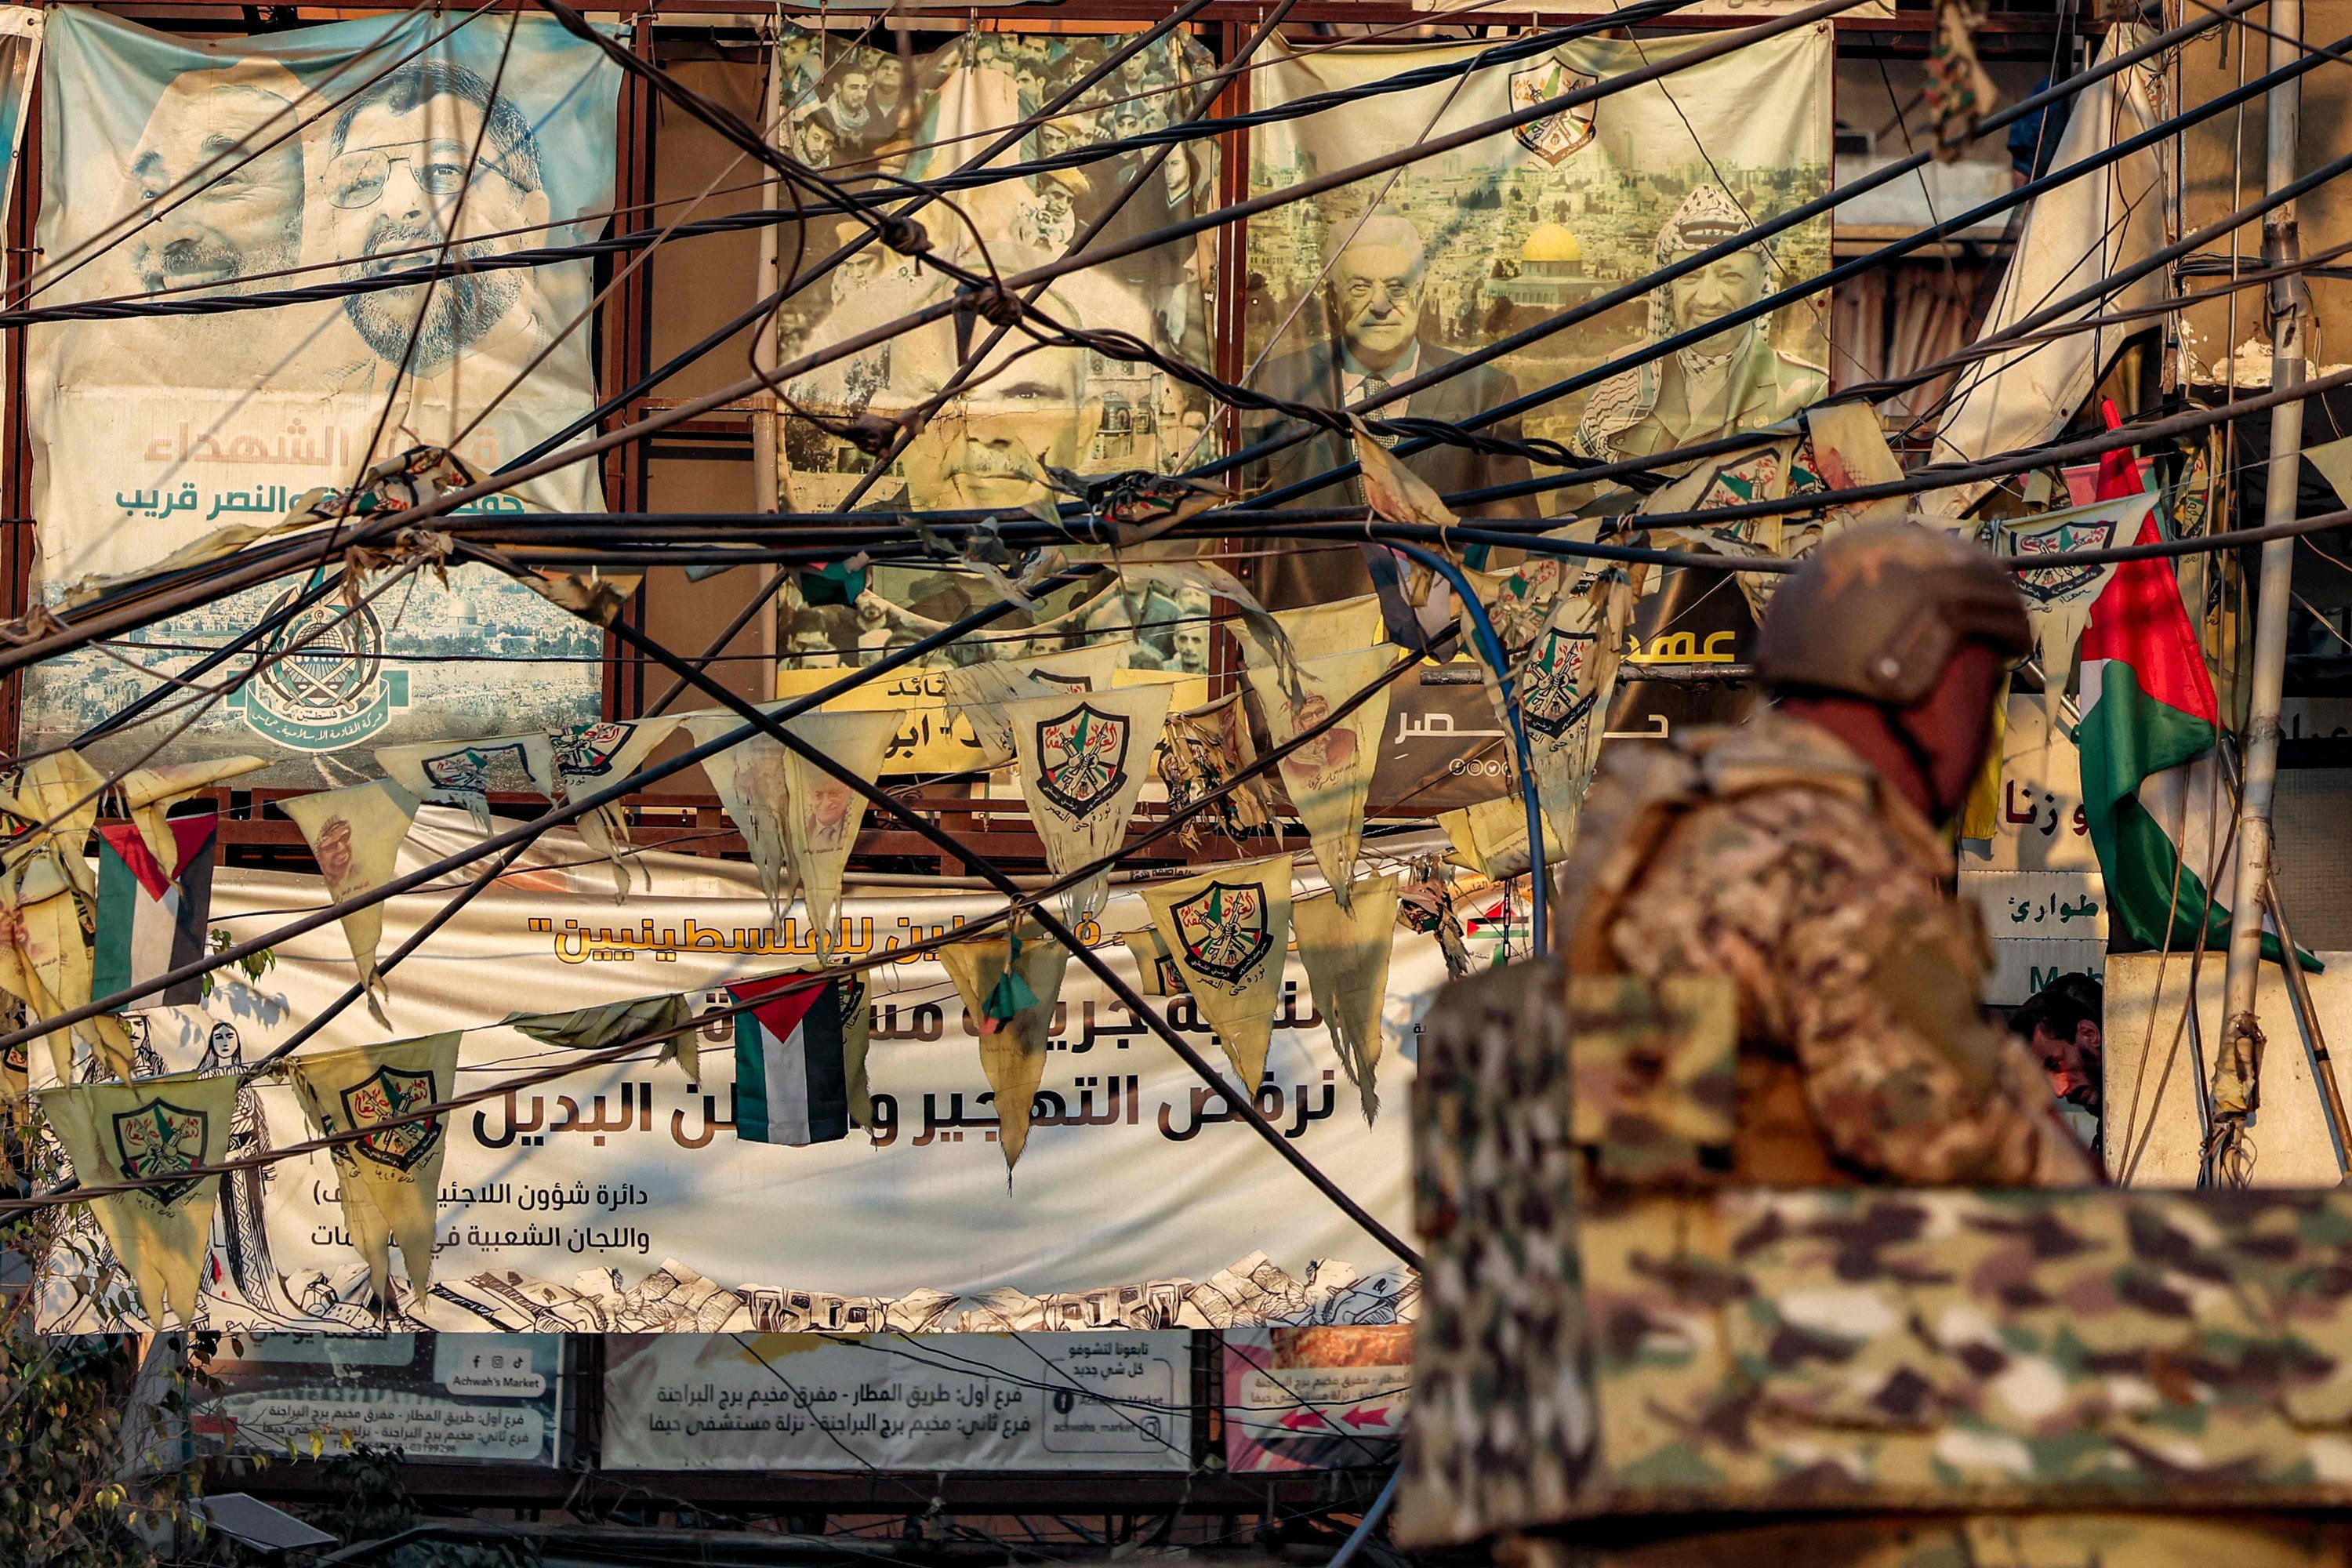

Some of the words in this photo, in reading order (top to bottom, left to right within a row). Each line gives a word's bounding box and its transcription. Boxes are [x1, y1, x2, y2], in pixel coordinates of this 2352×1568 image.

[144, 417, 350, 467] الشهداء
[116, 482, 198, 520] قريب
[2008, 892, 2100, 924] طوارئ
[472, 1081, 653, 1149] البديل
[1157, 1069, 1336, 1142] نرفض
[437, 1181, 511, 1209] اللاجئي
[517, 1181, 590, 1211] شؤون
[596, 1183, 648, 1214] دائرة
[466, 1223, 561, 1253] الشعبية
[567, 1225, 650, 1254] واللجان
[1115, 1342, 1149, 1359] تابعونا
[1073, 1365, 1098, 1378] جديد
[1101, 1361, 1126, 1381] شي
[1128, 1362, 1144, 1378] كل
[452, 1376, 501, 1388] Achwah's
[503, 1377, 539, 1388] Market
[658, 1383, 714, 1408] البراجنة
[718, 1388, 743, 1410] برج
[746, 1388, 789, 1410] مخيم
[793, 1388, 838, 1410] مفرق
[853, 1383, 902, 1408] المطار
[906, 1384, 950, 1409] طريق
[994, 1391, 1022, 1410] فرع
[332, 1410, 361, 1421] مخيم
[364, 1410, 395, 1423] مفرق
[405, 1410, 441, 1424] المطار
[444, 1410, 474, 1427] طريق
[648, 1412, 681, 1435] حيفا
[687, 1413, 771, 1436] مستشفى
[775, 1413, 804, 1436] نزلة
[819, 1413, 877, 1437] البراجنة
[880, 1416, 905, 1439] برج
[908, 1416, 950, 1439] مخيم
[1003, 1420, 1030, 1439] فرع
